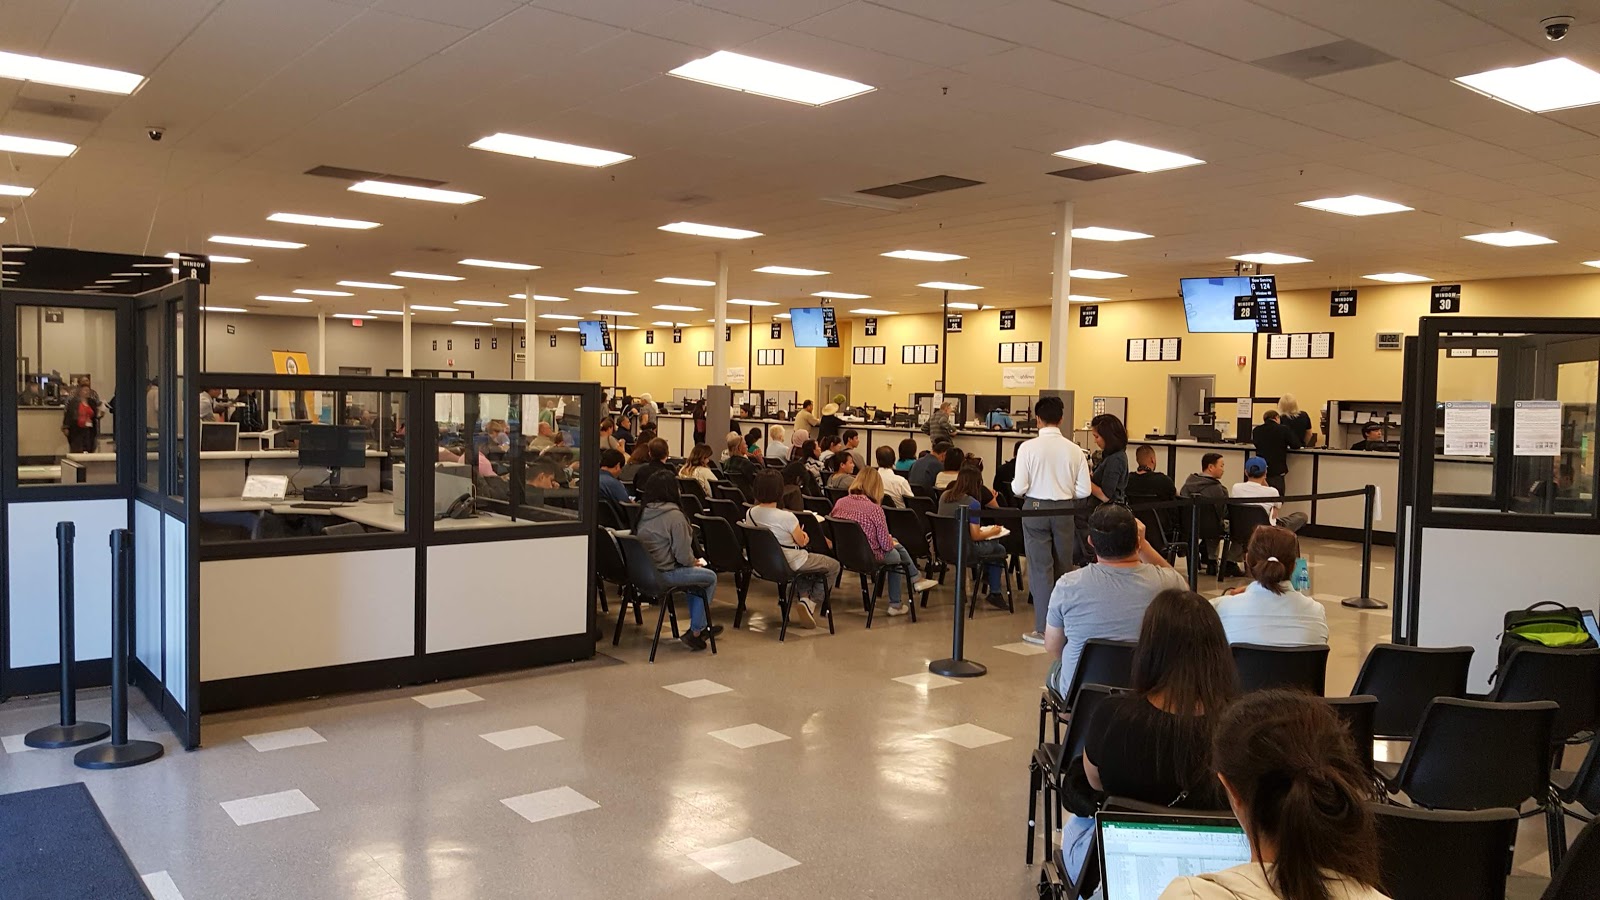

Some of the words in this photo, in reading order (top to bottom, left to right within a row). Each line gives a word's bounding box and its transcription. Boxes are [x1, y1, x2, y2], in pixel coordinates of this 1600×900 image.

[190, 268, 197, 278] 8
[1338, 303, 1349, 314] 29
[1440, 299, 1451, 310] 30
[1241, 308, 1250, 317] 28
[1004, 320, 1011, 328] 26
[1085, 316, 1093, 325] 27
